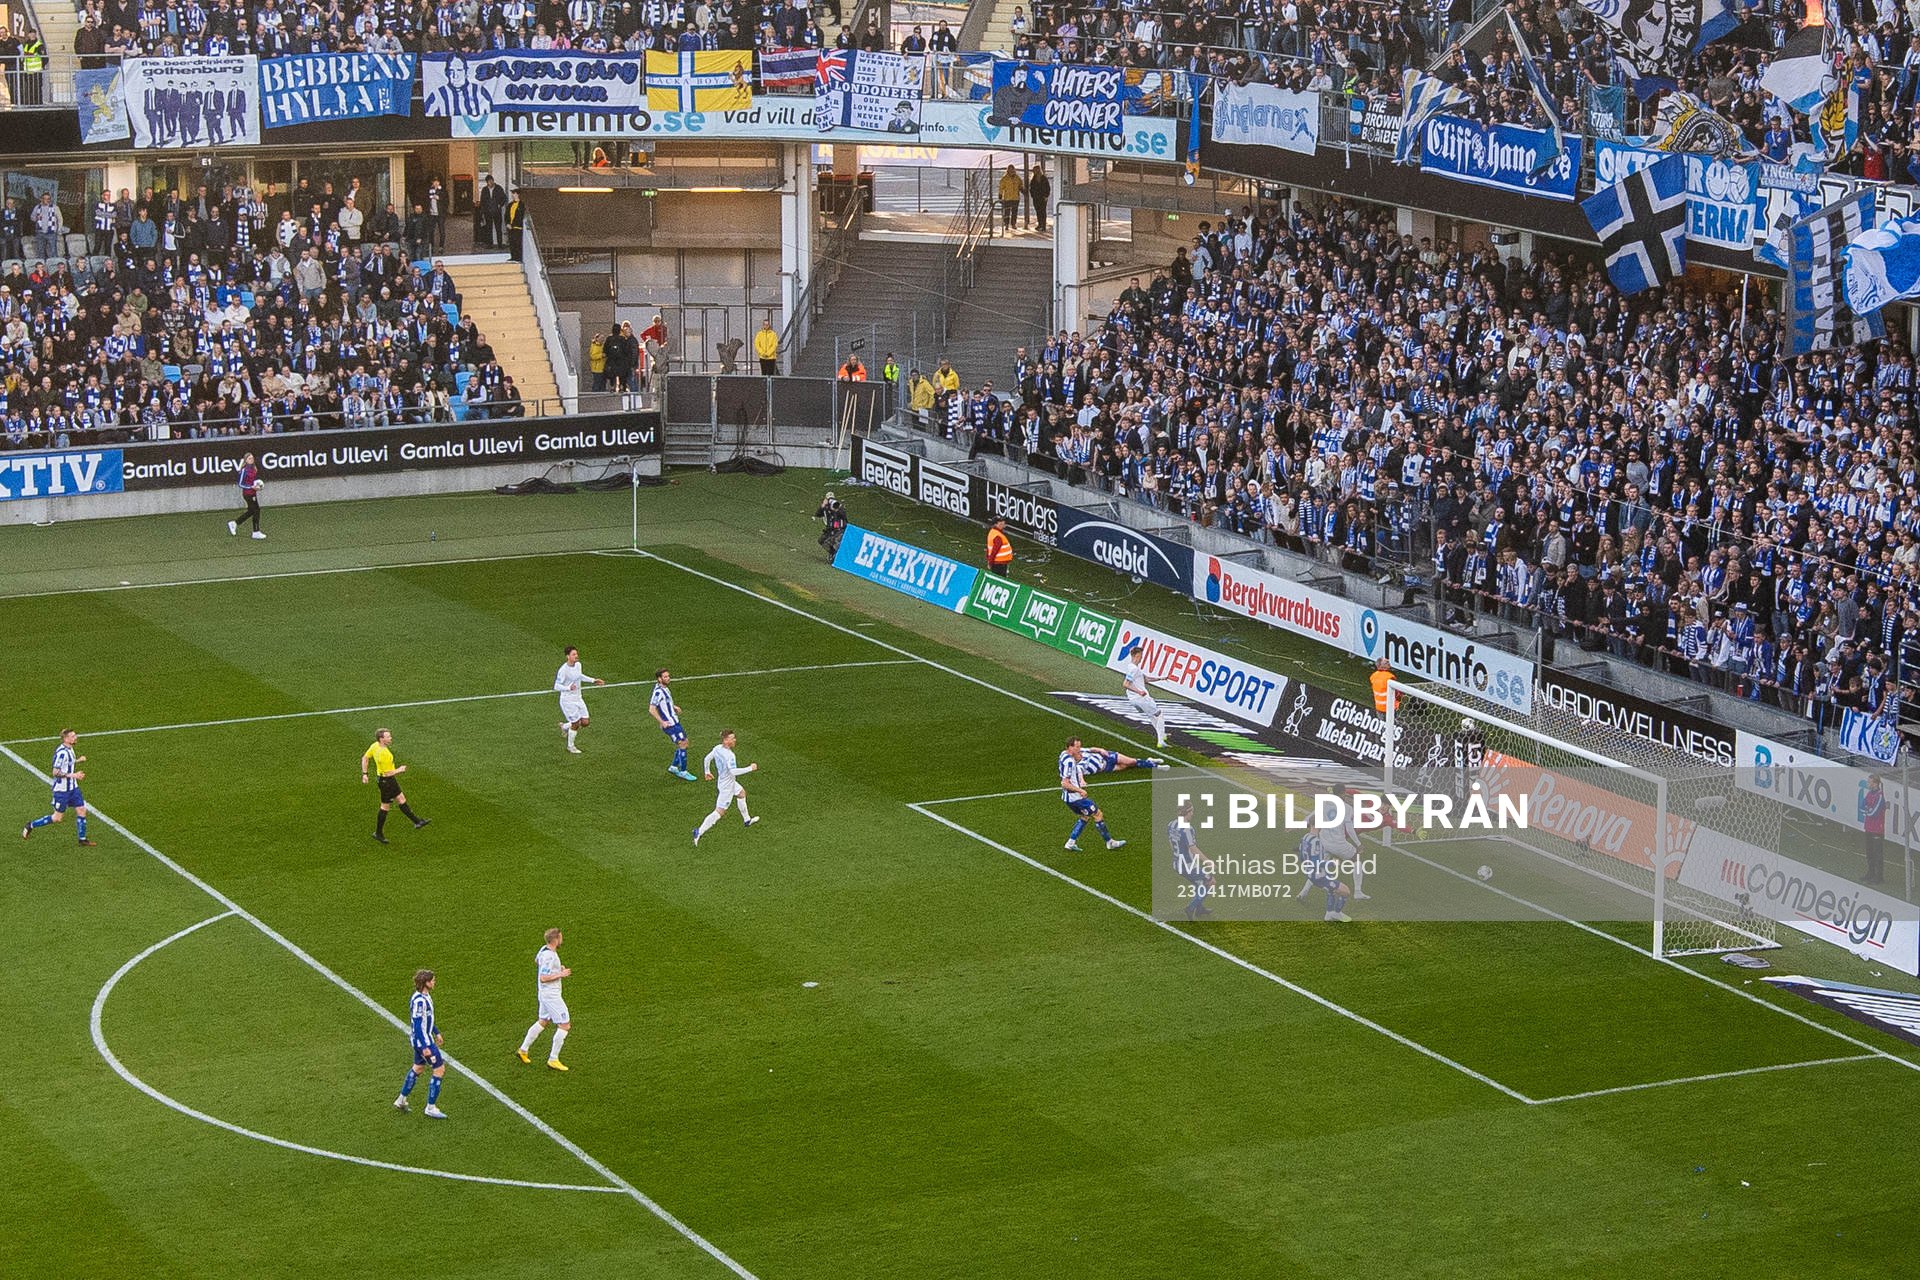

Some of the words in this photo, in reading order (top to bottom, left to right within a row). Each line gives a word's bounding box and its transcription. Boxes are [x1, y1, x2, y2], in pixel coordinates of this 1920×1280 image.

[13, 12, 25, 37] F2
[142, 66, 244, 77] gothenburg
[262, 53, 412, 93] BEBBENS
[648, 77, 690, 85] BACKA
[1050, 65, 1121, 100] HATERS
[538, 84, 609, 102] TOUR
[834, 81, 919, 99] LONDONERS
[499, 109, 705, 132] merinfo.se
[767, 107, 796, 125] vill
[853, 104, 890, 113] LOYALTY
[857, 113, 884, 121] NEVER
[1044, 99, 1121, 130] CORNER
[1368, 99, 1387, 114] THE
[1363, 112, 1401, 130] BROWN
[1361, 126, 1400, 145] BOMBE
[400, 441, 464, 461] Gamla
[469, 435, 523, 456] Ullevi
[535, 431, 597, 452] Gamla
[602, 427, 655, 448] Ullevi
[123, 458, 187, 480] Gamla
[192, 456, 246, 475] Ullev
[262, 450, 327, 471] Gamla
[332, 445, 389, 467] Ullevi
[861, 438, 912, 496] Peekab
[918, 457, 970, 517] Peekab
[986, 480, 1059, 534] Helanders
[854, 532, 958, 595] EFFEKTIV
[1093, 538, 1149, 579] cuebid
[981, 581, 1010, 610] MCR
[1222, 573, 1341, 639] Bergkvarabuss
[1028, 599, 1058, 627] MCR
[1076, 617, 1107, 646] MCR
[1138, 637, 1276, 714] INTERSPORT
[1384, 630, 1526, 706] merinfo.se
[1839, 706, 1880, 753] IFK
[1316, 718, 1413, 770] Metallparier
[1529, 772, 1633, 852] Renova
